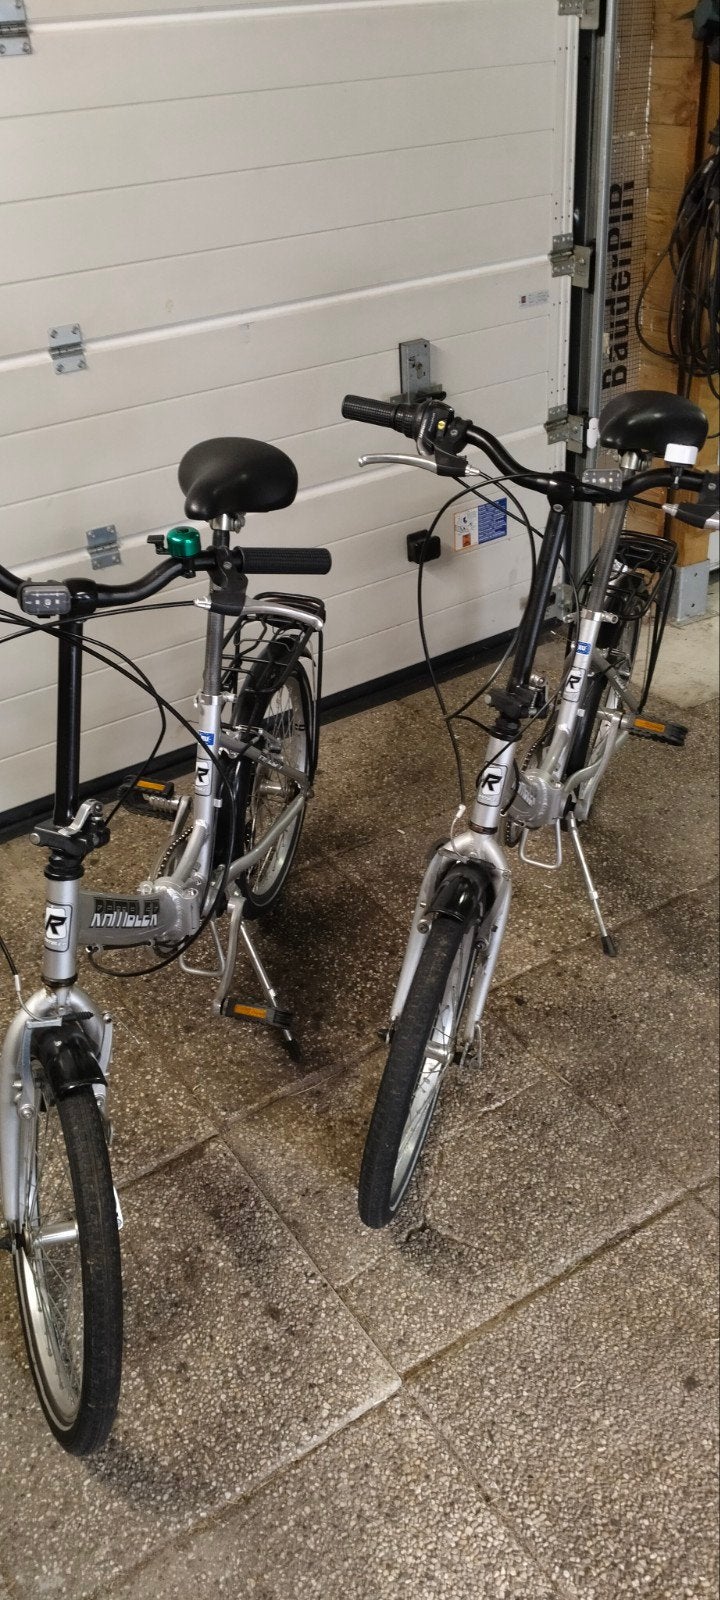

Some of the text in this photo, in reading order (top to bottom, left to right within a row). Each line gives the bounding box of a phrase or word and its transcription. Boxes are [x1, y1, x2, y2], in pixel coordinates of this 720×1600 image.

[566, 675, 582, 690] R
[481, 773, 503, 791] R
[89, 897, 159, 929] RAMBLER
[45, 913, 68, 935] R
